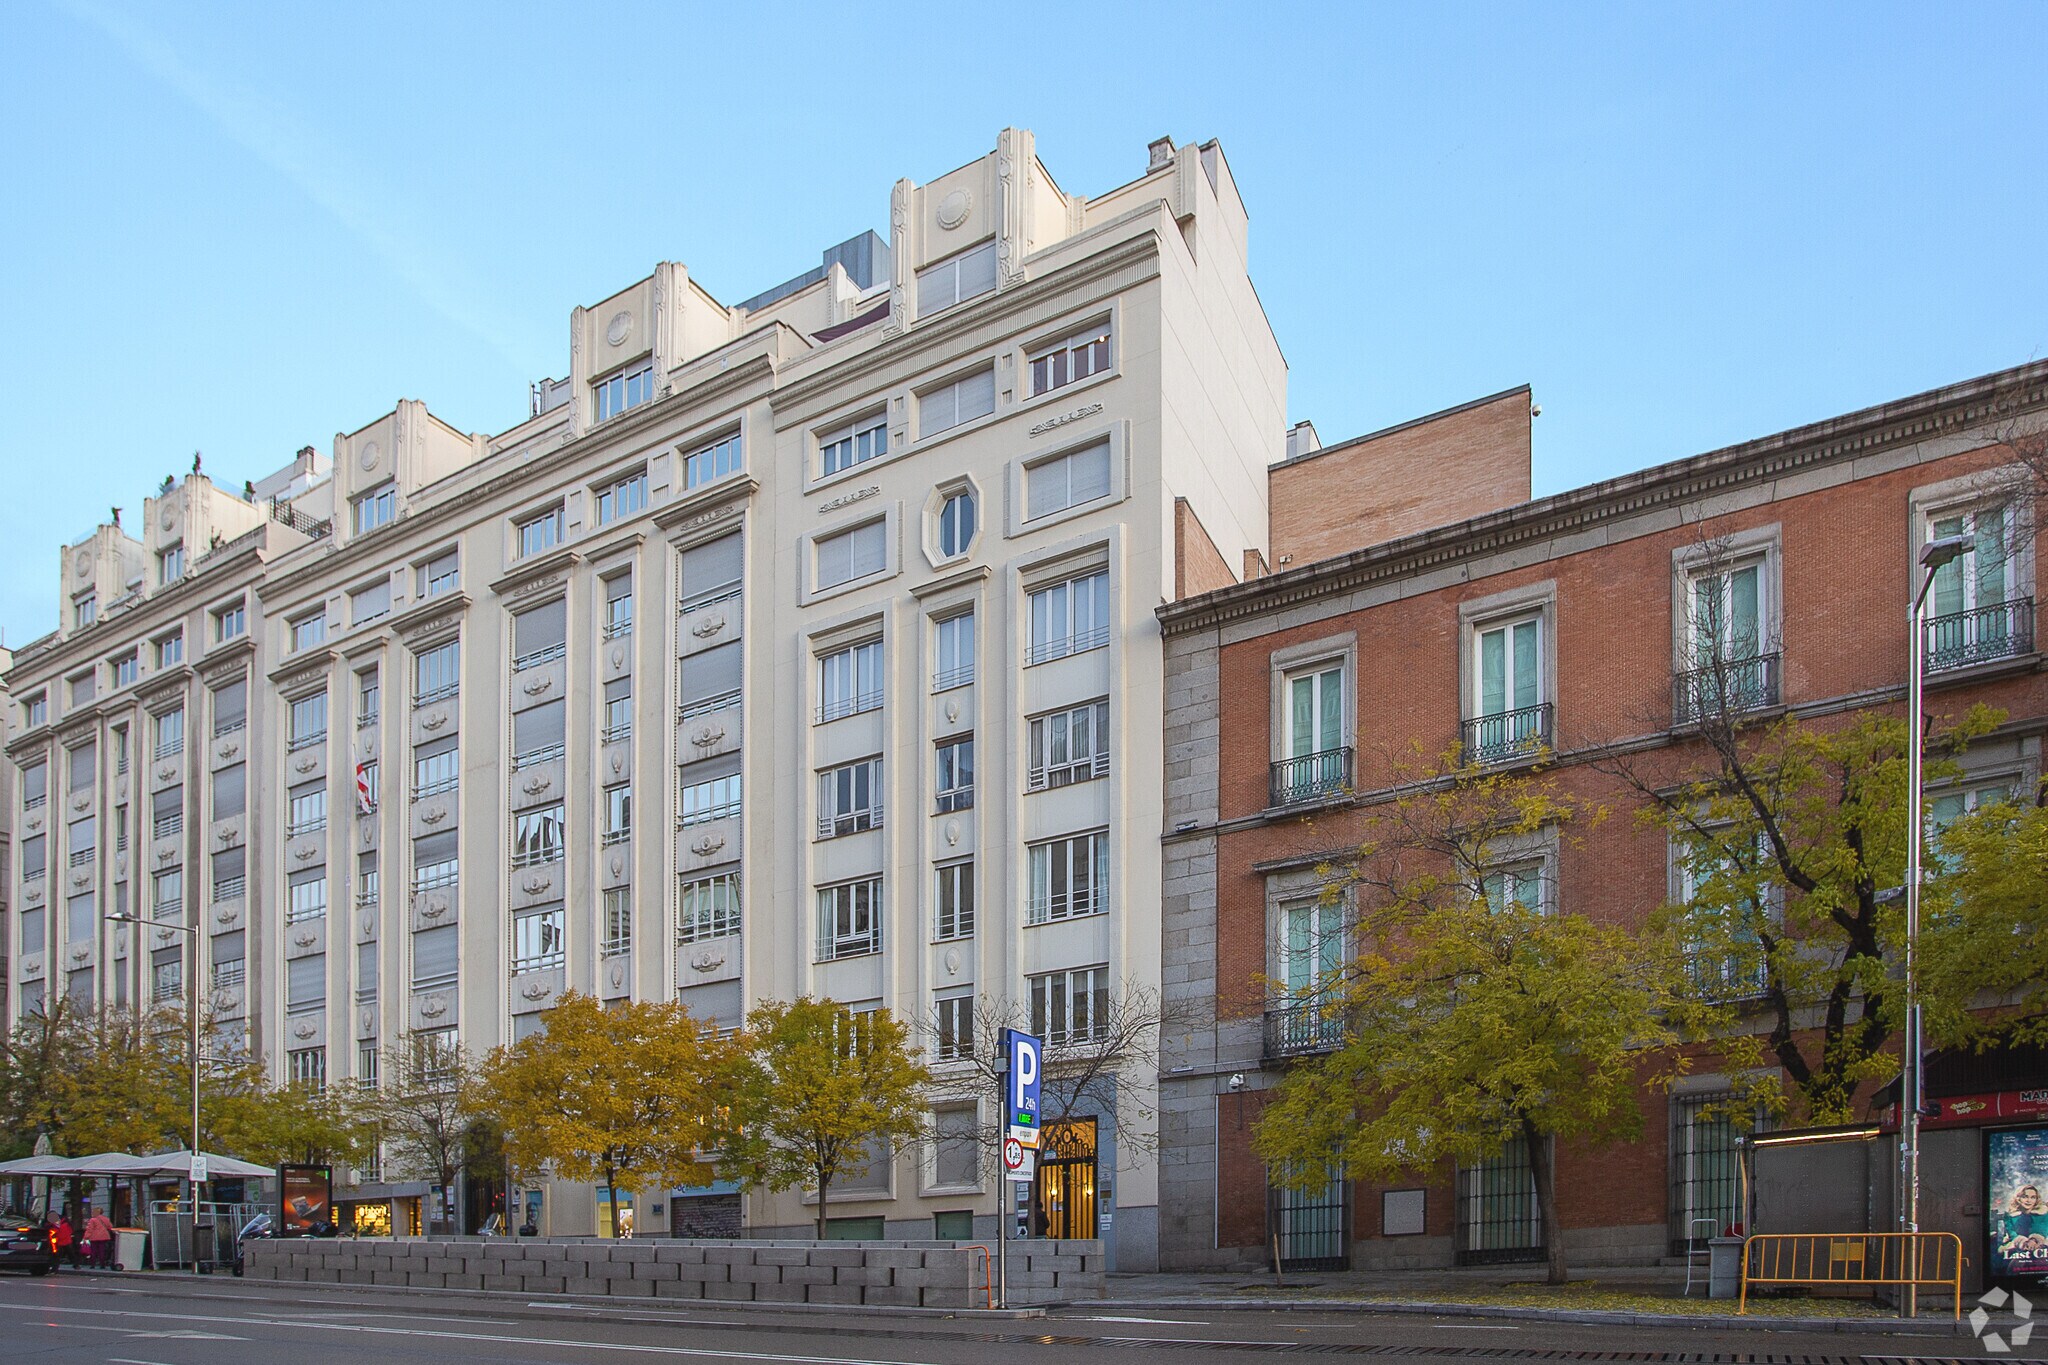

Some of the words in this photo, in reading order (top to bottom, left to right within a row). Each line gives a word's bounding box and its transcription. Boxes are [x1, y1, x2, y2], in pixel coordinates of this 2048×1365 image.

[1017, 1041, 1037, 1109] P
[1025, 1096, 1036, 1111] 24h
[1955, 1101, 1968, 1109] hop
[1956, 1106, 1971, 1115] hop
[2003, 1250, 2031, 1260] Last
